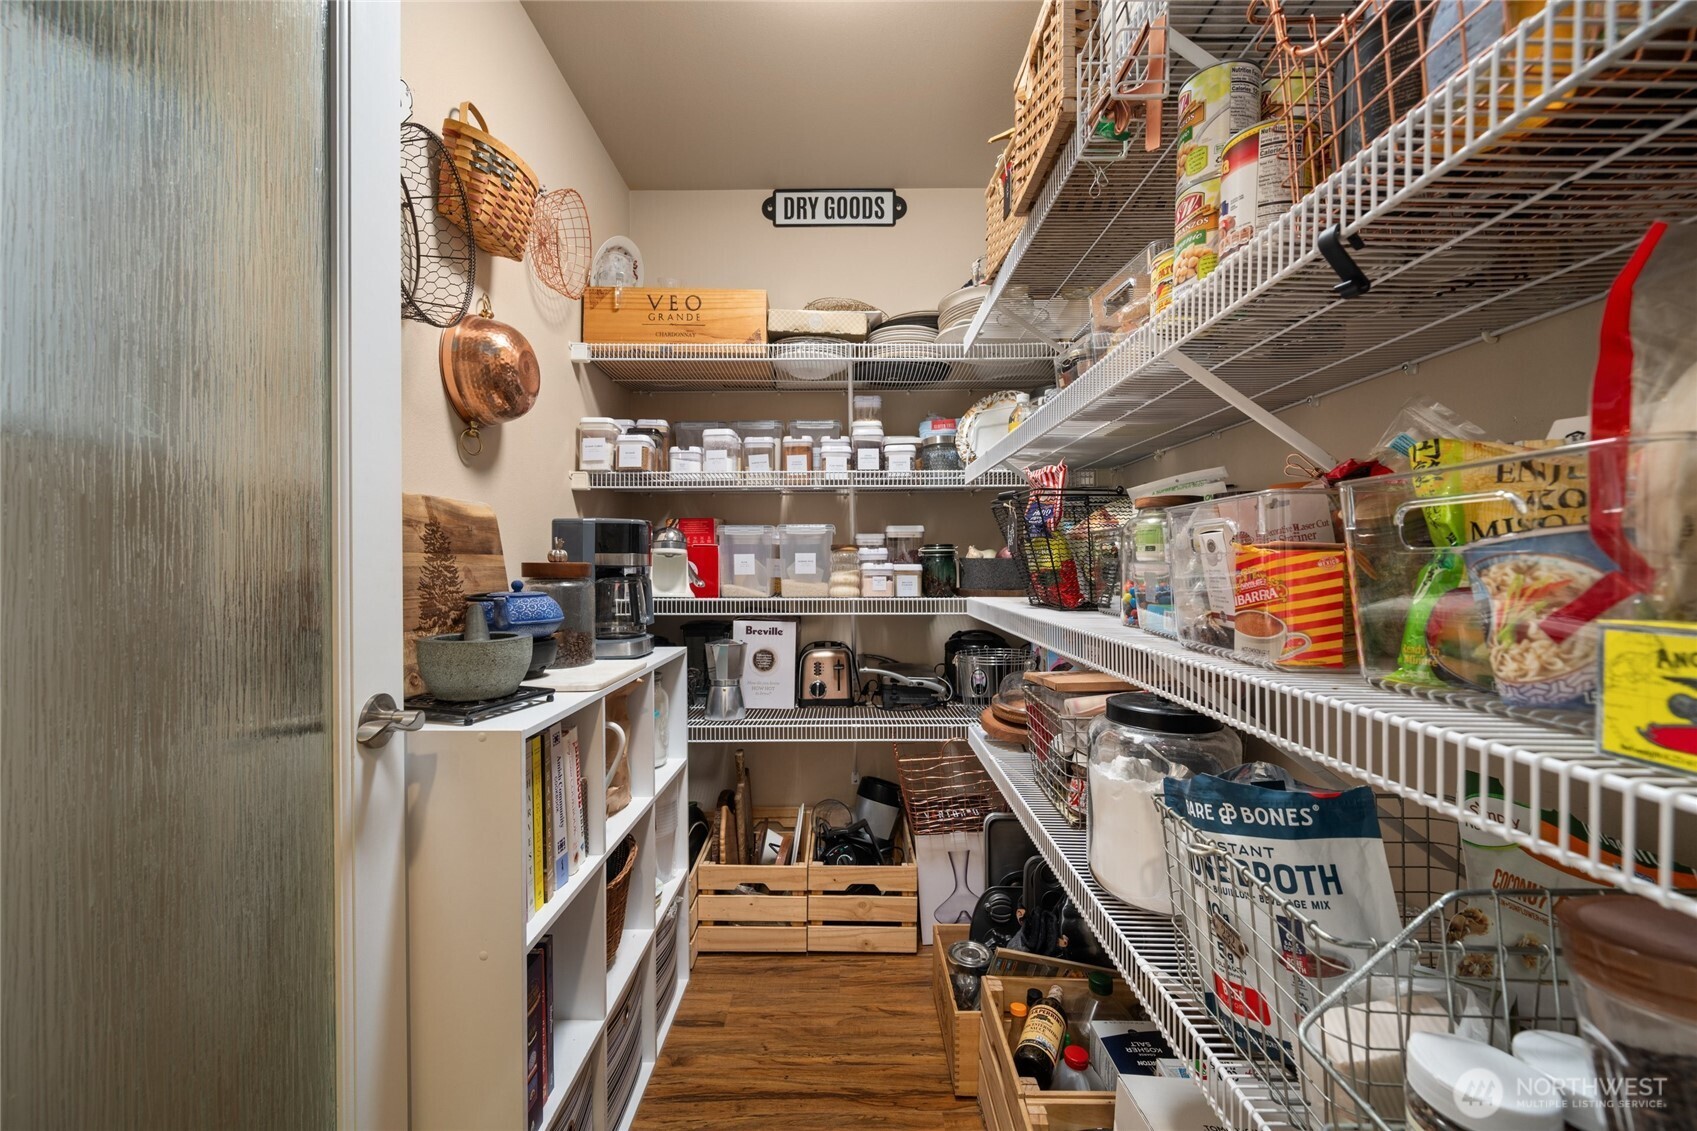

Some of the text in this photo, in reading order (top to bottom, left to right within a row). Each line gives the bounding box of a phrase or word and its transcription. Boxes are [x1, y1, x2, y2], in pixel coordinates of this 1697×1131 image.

[784, 196, 885, 220] DRY GOODS
[647, 294, 702, 312] VEO
[648, 313, 701, 321] GRANDE
[1316, 519, 1330, 528] Cut
[1235, 587, 1279, 607] IBARRA
[745, 625, 784, 636] Breville
[1217, 841, 1274, 859] STANT
[1259, 894, 1307, 910] BEVEAGE
[1311, 900, 1331, 910] MIX
